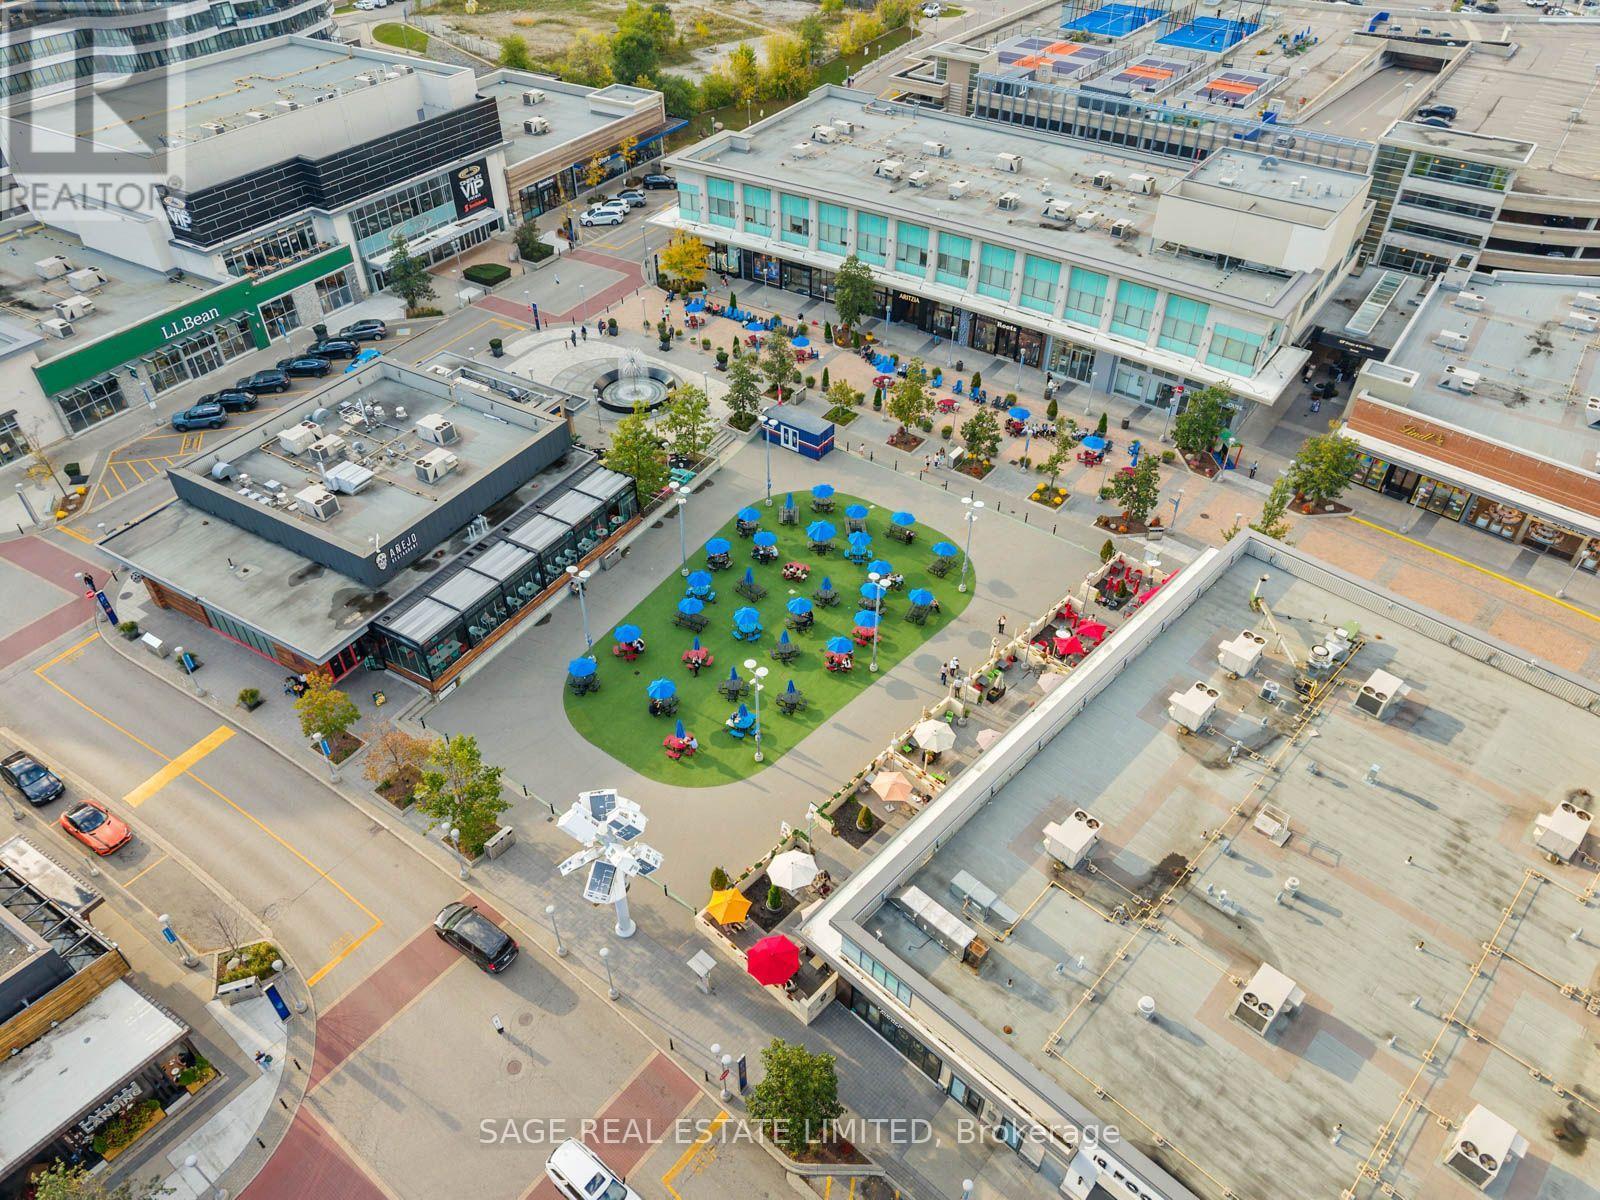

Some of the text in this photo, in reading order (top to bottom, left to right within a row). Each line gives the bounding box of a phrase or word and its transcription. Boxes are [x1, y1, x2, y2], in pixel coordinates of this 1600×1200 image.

[460, 179, 484, 199] VIP
[167, 210, 192, 228] VIP
[899, 293, 920, 304] ARITZIA
[161, 307, 220, 339] L.L.Bean
